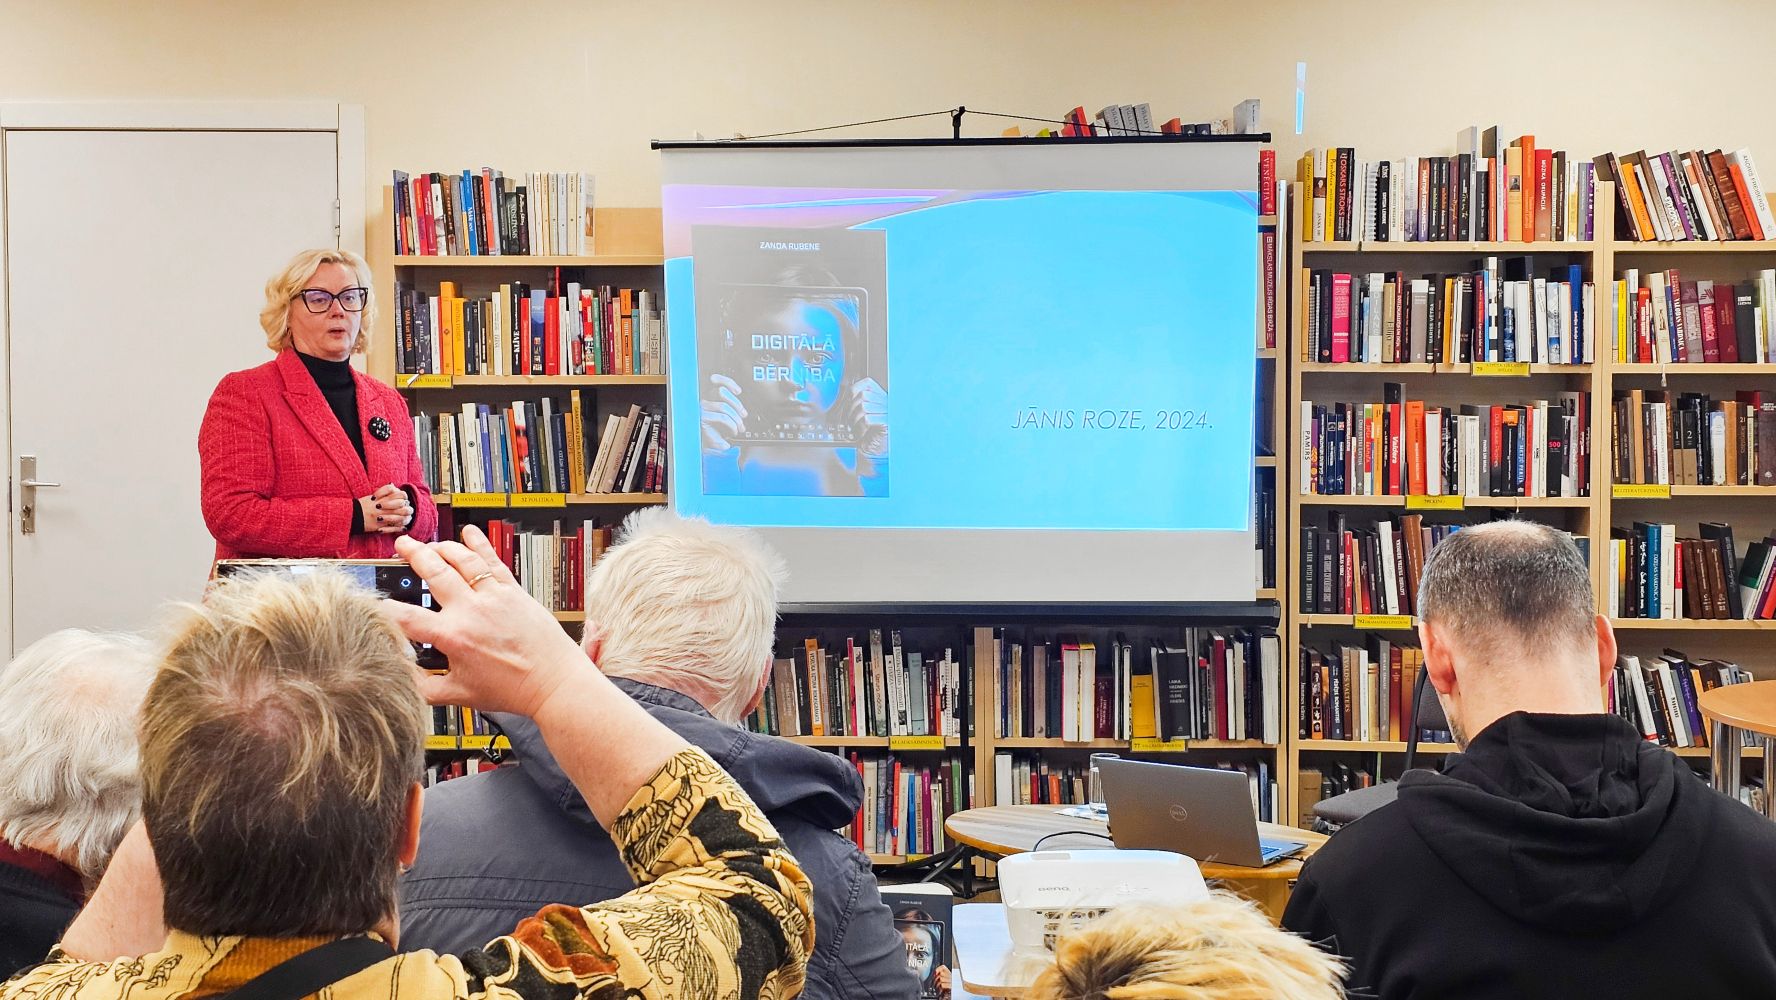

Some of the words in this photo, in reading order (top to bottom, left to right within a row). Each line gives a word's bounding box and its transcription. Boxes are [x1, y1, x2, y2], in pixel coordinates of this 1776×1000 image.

[1262, 157, 1272, 202] VENĒCIJA
[1339, 160, 1347, 187] OSKARS
[1338, 188, 1346, 216] STROKS
[759, 241, 787, 250] ZANDA
[788, 242, 820, 251] RUBENE
[1266, 243, 1274, 271] MĀKSLAS
[1266, 271, 1274, 296] MUZEJS
[751, 333, 835, 351] DIGITĀLĀ
[753, 364, 836, 382] BĒRNĪBA
[1010, 406, 1075, 430] JĀNIS
[1082, 410, 1146, 431] ROZE,
[1155, 410, 1214, 430] 2024.
[1687, 430, 1693, 439] 2
[1548, 440, 1561, 448] 500
[905, 942, 929, 952] ITĀLĀ
[907, 957, 929, 968] NĪBA
